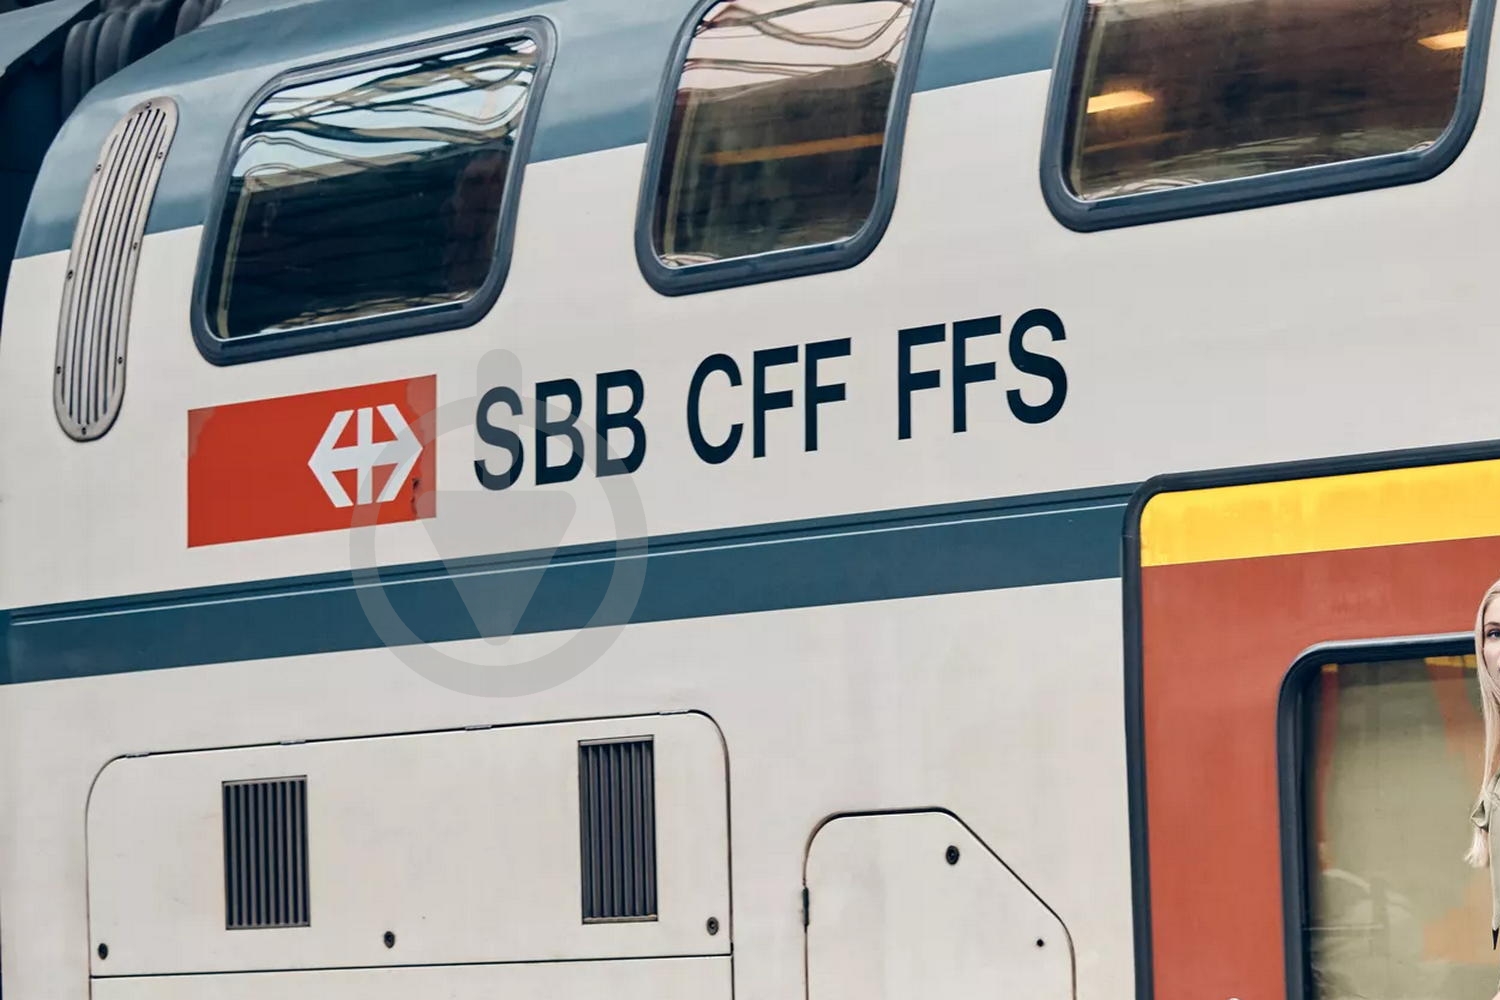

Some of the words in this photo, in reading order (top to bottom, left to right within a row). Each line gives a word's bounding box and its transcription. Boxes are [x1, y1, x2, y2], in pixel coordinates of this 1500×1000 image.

[474, 368, 647, 491] SBB
[687, 337, 851, 465] CFF
[898, 308, 1068, 441] FFS
